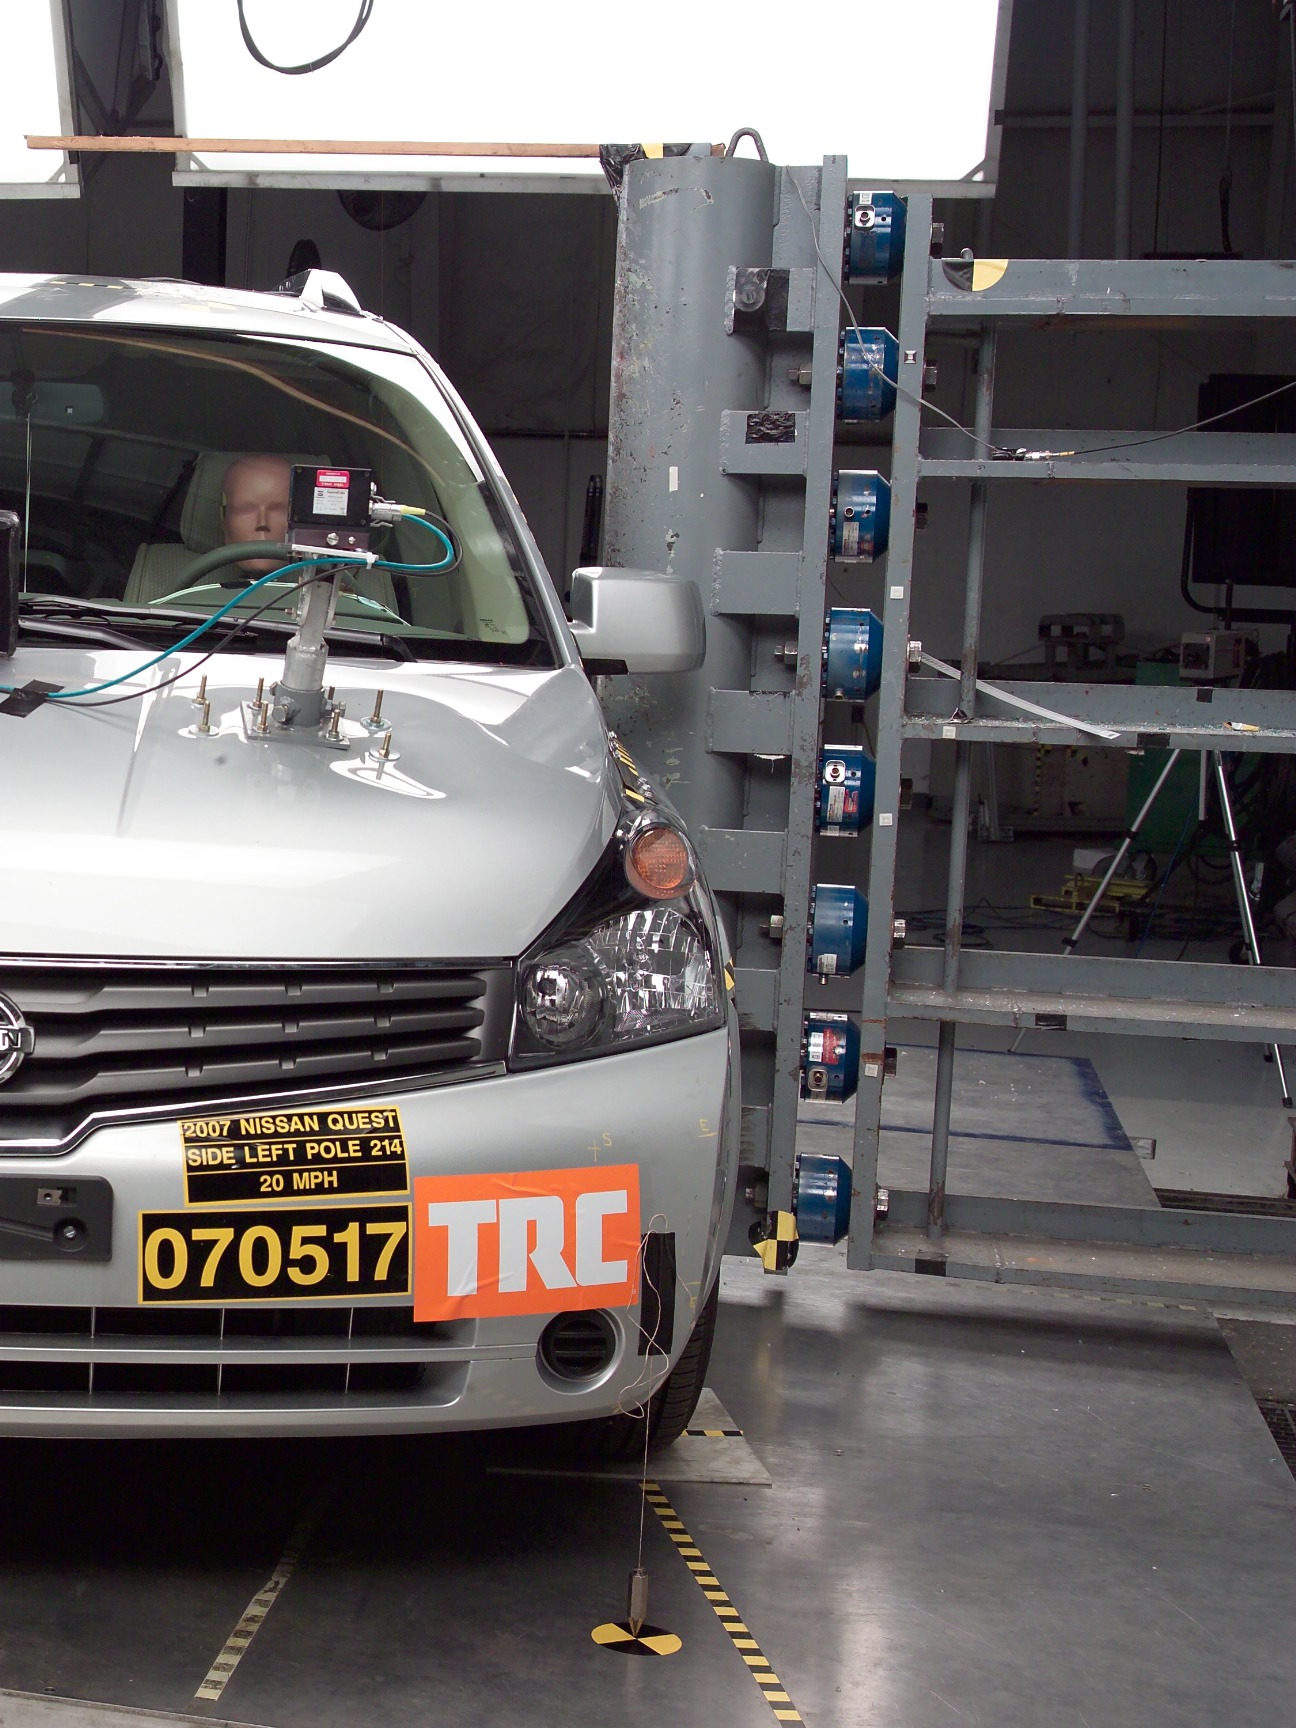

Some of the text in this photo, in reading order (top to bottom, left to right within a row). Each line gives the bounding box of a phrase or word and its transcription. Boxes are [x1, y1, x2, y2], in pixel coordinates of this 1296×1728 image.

[183, 1111, 397, 1139] 2007 NISSAN QUEST
[186, 1138, 403, 1167] SIDE LEFT POLE 214
[259, 1171, 338, 1192] 20 MPH
[144, 1221, 408, 1289] 070517
[428, 1189, 628, 1296] TRC
